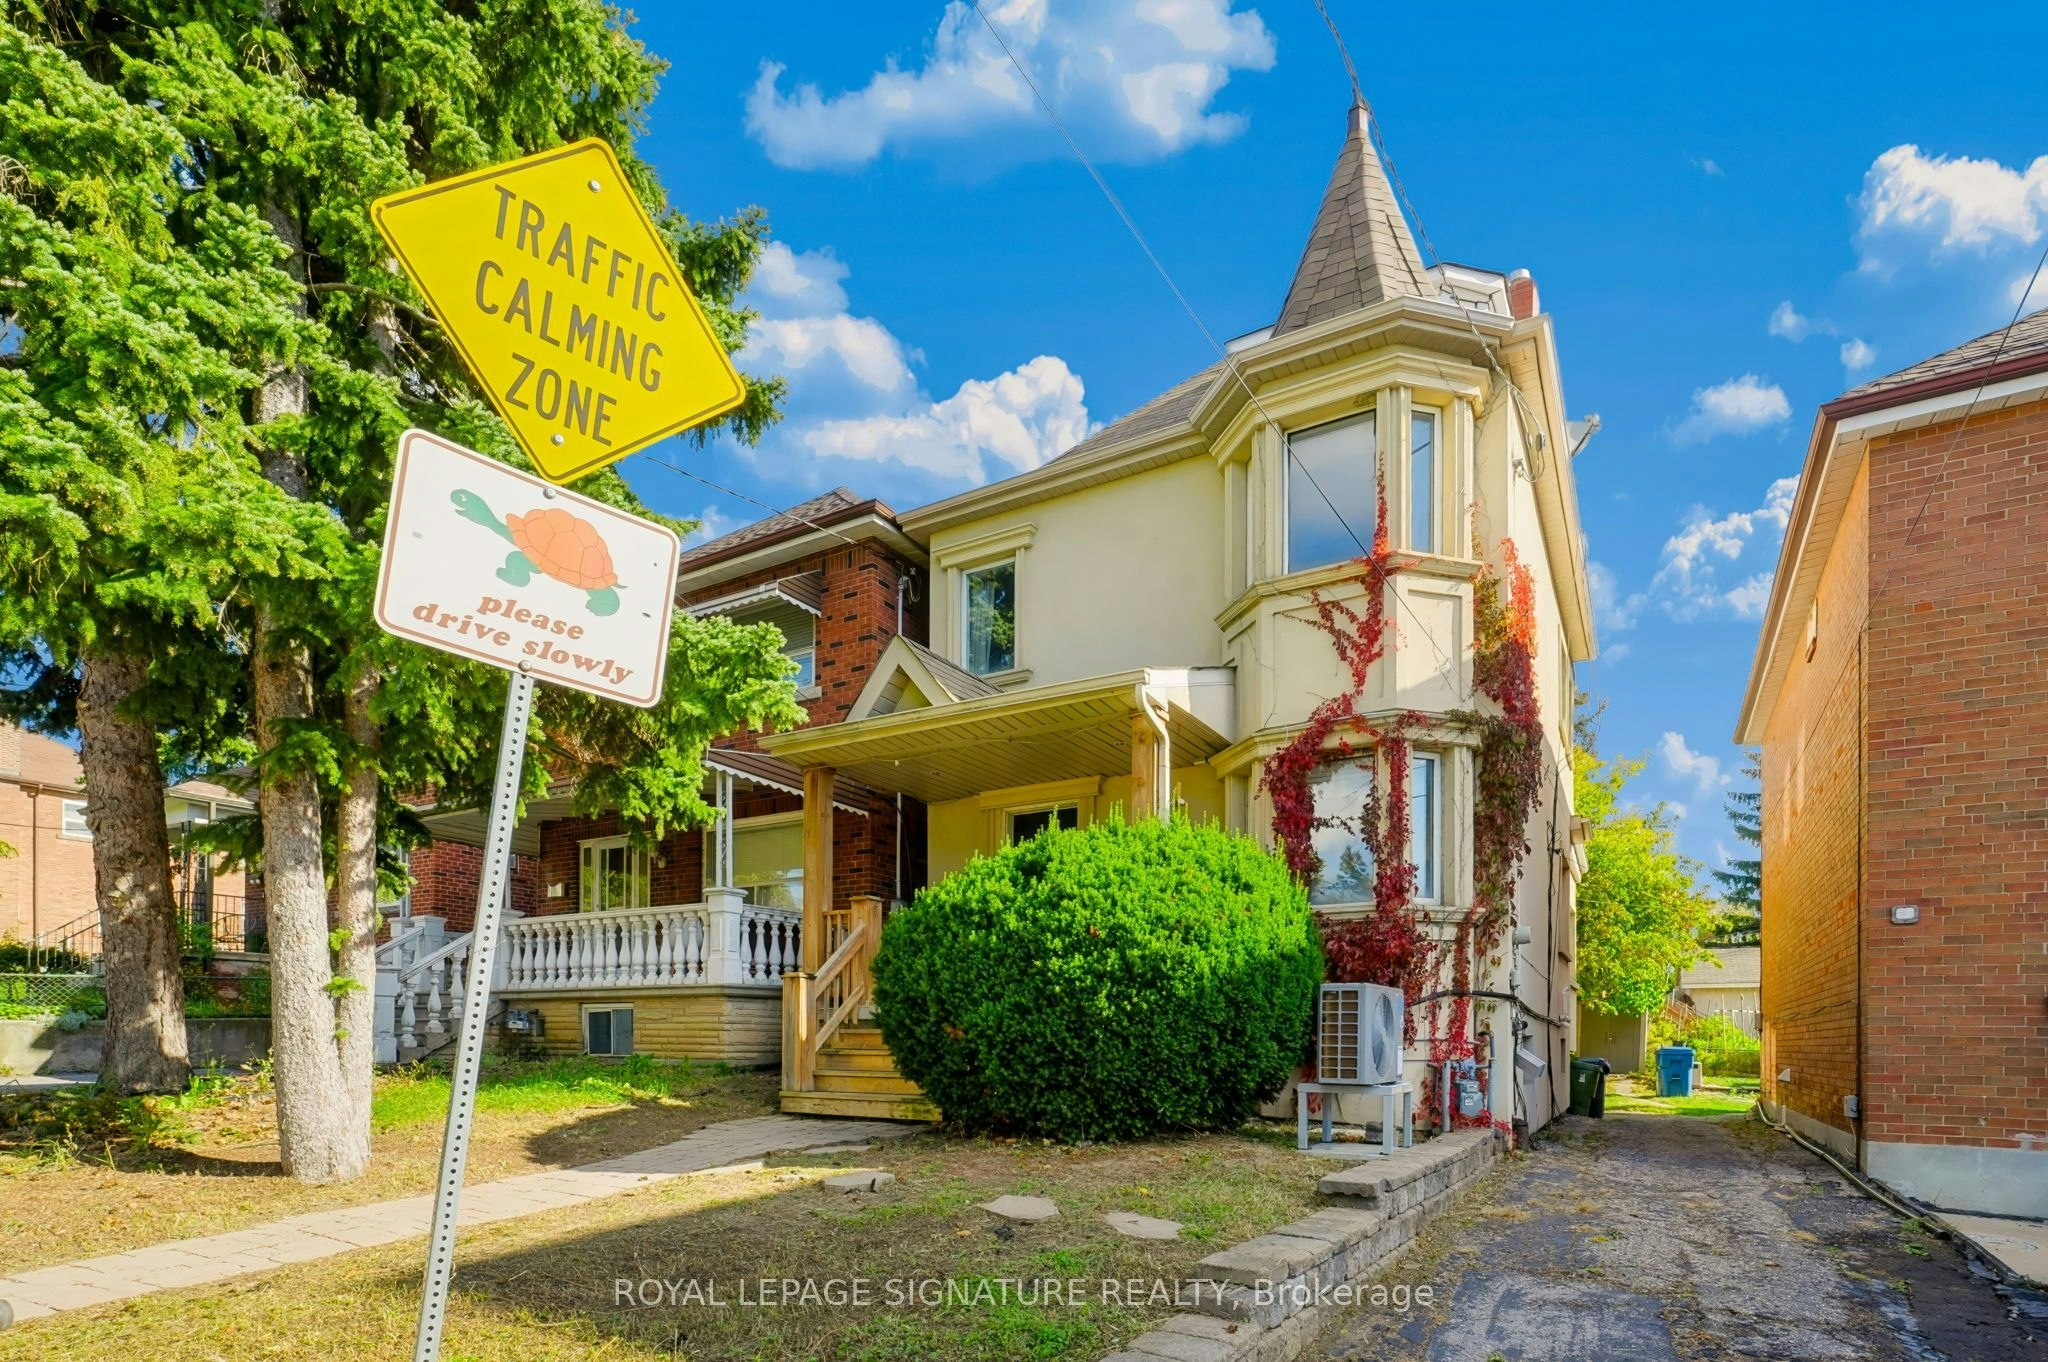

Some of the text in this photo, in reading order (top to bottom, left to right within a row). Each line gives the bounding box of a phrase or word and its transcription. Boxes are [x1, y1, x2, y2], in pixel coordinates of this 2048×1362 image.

[494, 184, 670, 322] TRAFFIC
[476, 260, 663, 392] CALMING
[504, 352, 617, 447] ZONE
[412, 603, 634, 685] drive slowly
[476, 596, 584, 641] please
